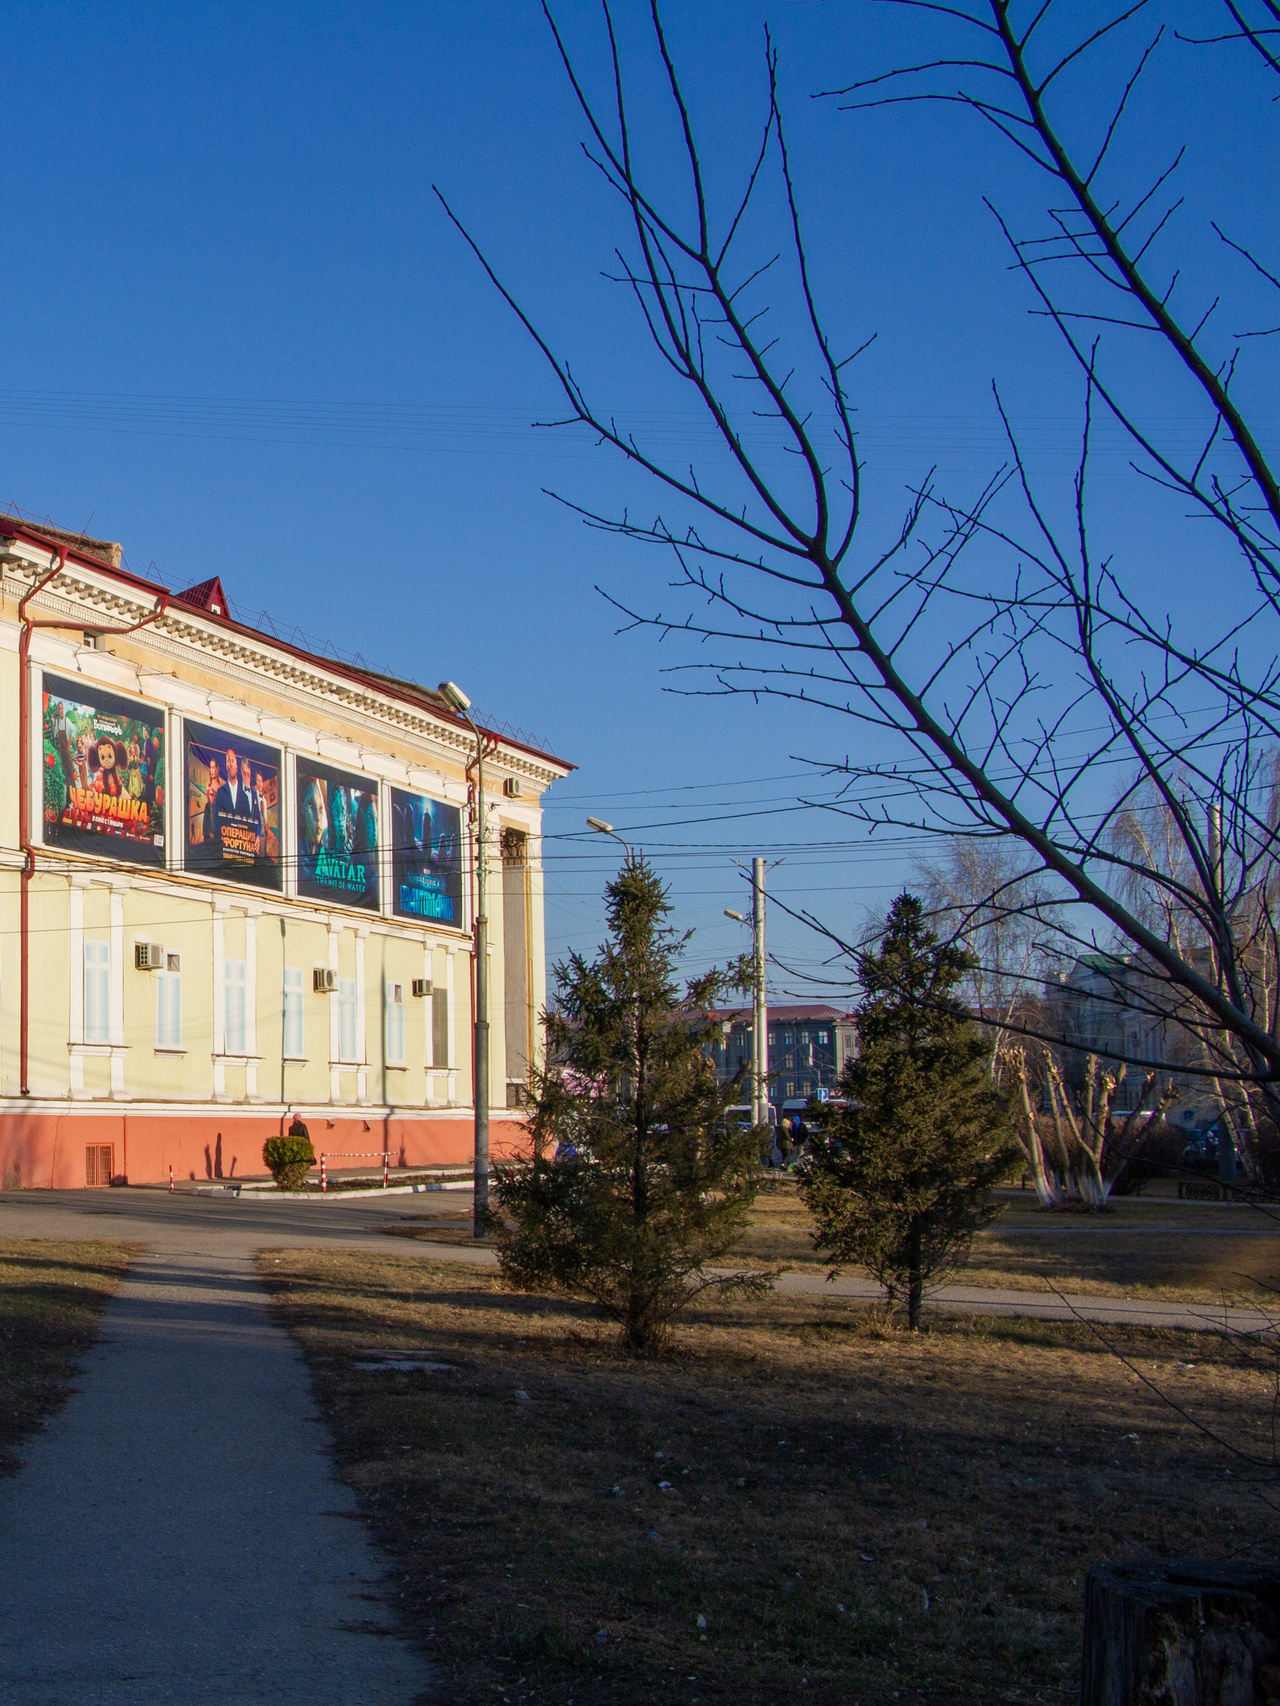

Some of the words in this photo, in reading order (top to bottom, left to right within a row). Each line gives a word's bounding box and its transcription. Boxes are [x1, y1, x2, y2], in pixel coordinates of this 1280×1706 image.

[69, 785, 148, 823] ЧЕБУРАШКА
[221, 825, 256, 842] ОПЕРАЦИЯ
[314, 845, 367, 883] AVATAR
[315, 875, 327, 884] THE
[327, 879, 338, 887] WAY
[338, 881, 345, 889] OF
[346, 882, 366, 893] WATER
